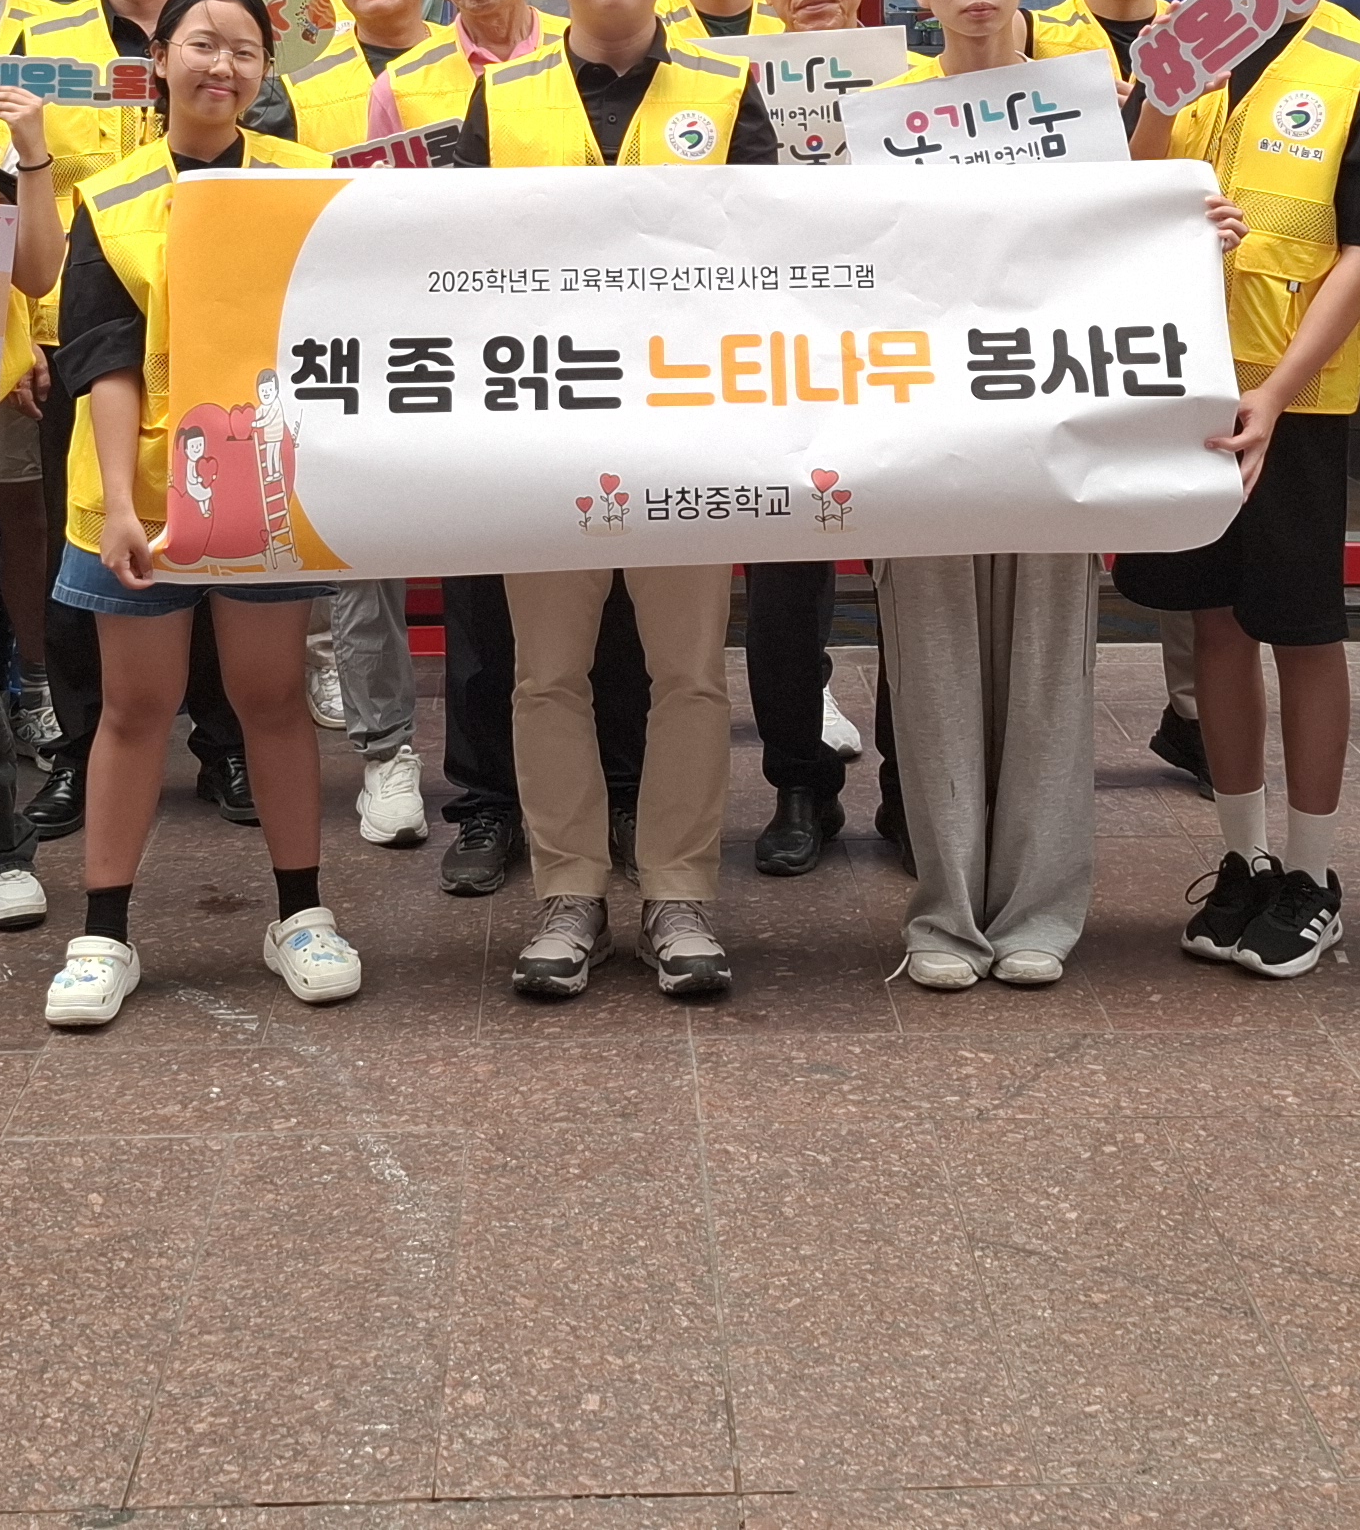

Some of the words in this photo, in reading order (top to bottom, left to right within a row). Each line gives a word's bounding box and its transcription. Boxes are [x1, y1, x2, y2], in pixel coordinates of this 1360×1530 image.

[428, 269, 551, 294] 2025학년도
[559, 264, 779, 292] 교육복지우선지원사업
[788, 263, 875, 290] 프로그램
[290, 336, 361, 416] 책
[386, 336, 455, 414] 좀
[482, 334, 624, 411] 읽는
[646, 329, 935, 407] 느티나무
[966, 322, 1187, 402] 봉사단
[644, 485, 791, 521] 남창중학교
